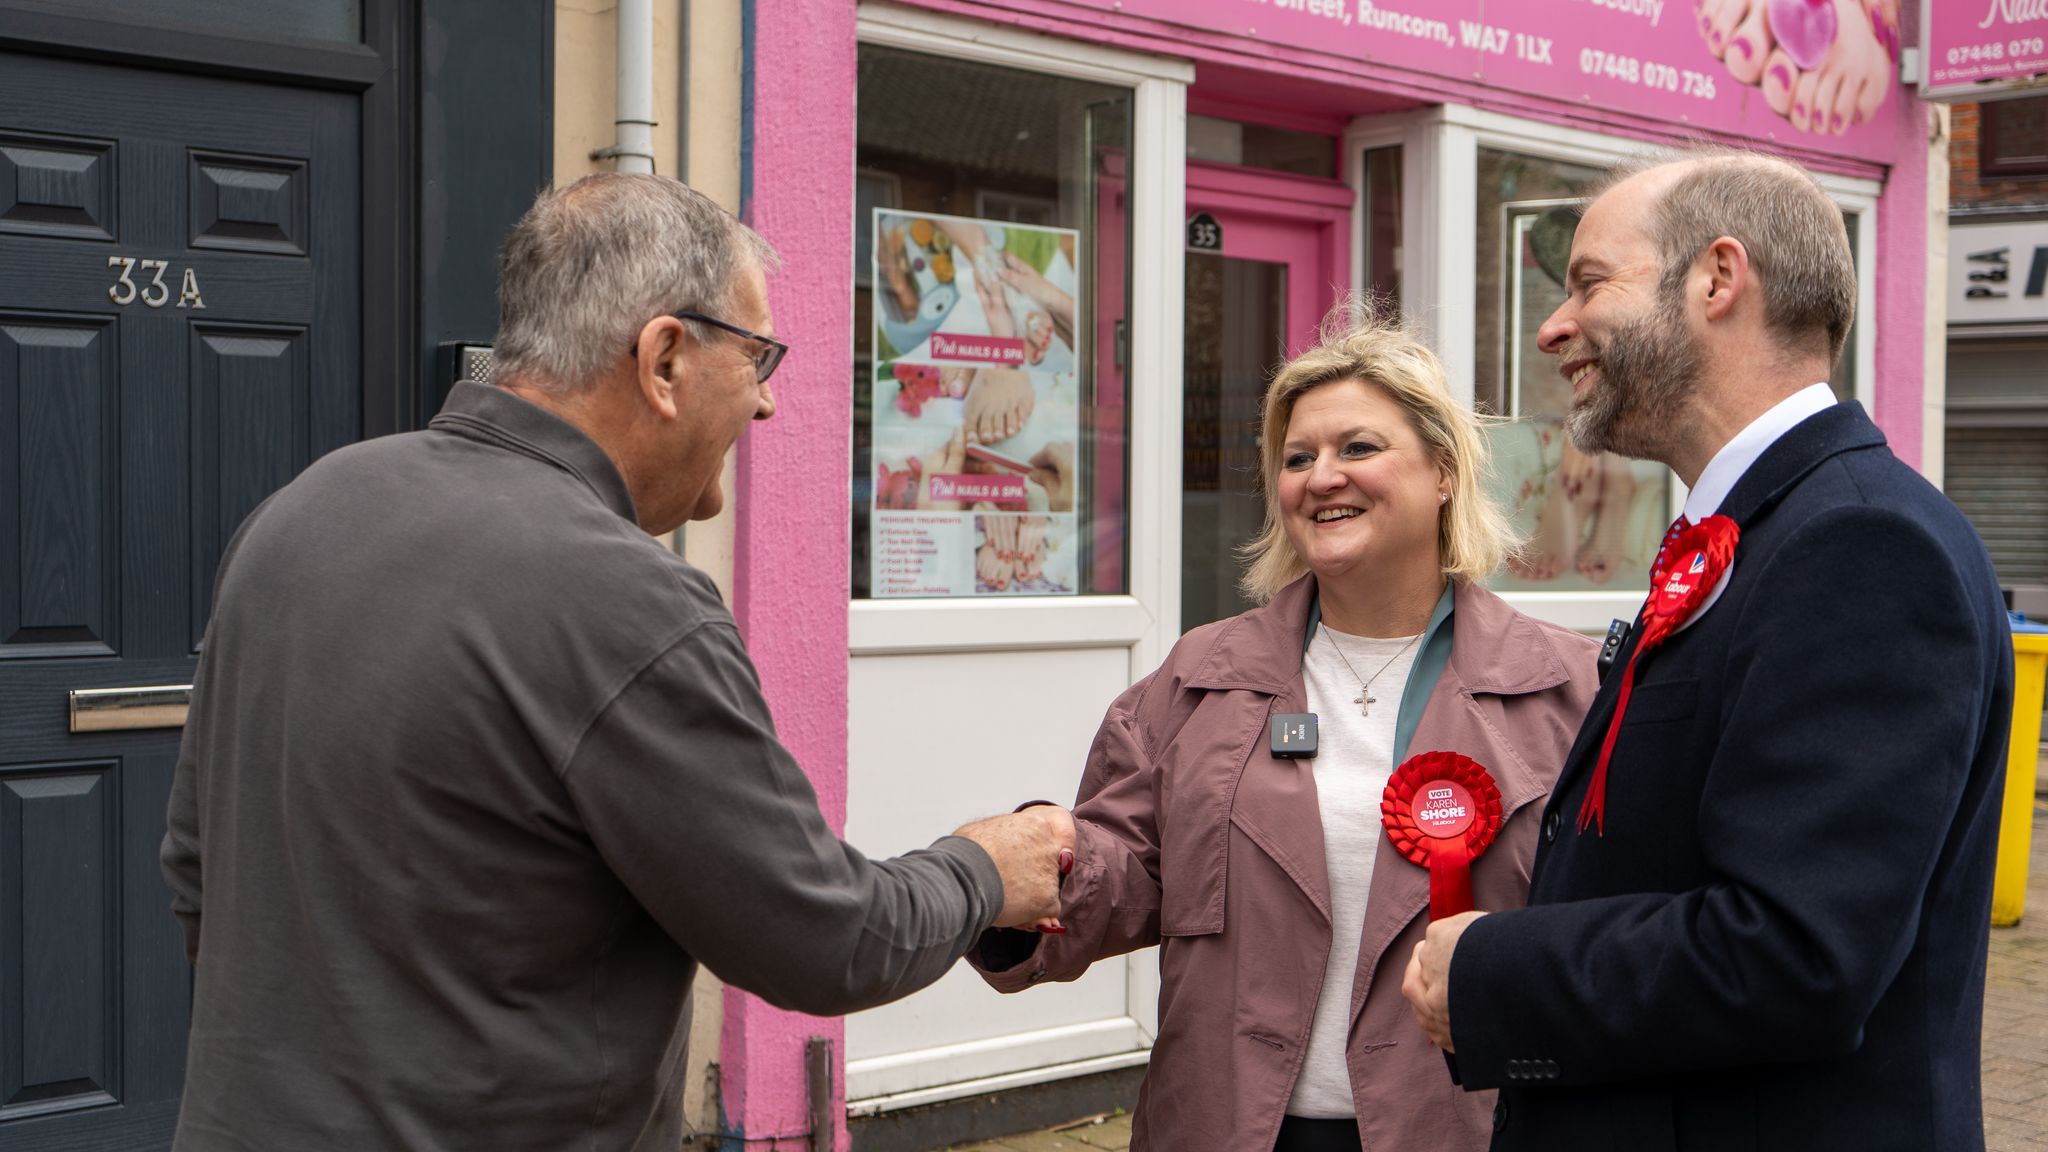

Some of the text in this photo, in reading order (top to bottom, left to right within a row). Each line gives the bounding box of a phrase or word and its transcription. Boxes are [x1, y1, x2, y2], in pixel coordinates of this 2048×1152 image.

[1358, 0, 1456, 48] Runcorn,
[1459, 19, 1510, 55] WA7
[1515, 32, 1554, 64] 1LX
[1579, 47, 1640, 84] 07448
[1643, 61, 1679, 92] 070
[1682, 69, 1716, 100] 736
[1946, 37, 2044, 65] 07448 070
[1193, 223, 1217, 247] 35
[1966, 246, 2010, 298] P&A
[957, 345, 991, 359] NAILS
[992, 347, 1001, 359] &
[1003, 348, 1024, 360] SPA
[957, 485, 990, 497] NAILS
[991, 486, 999, 497] &
[1001, 486, 1024, 498] SPA
[1430, 790, 1451, 798] VOTE
[1426, 799, 1458, 809] KAREN
[1420, 807, 1466, 821] SHORE
